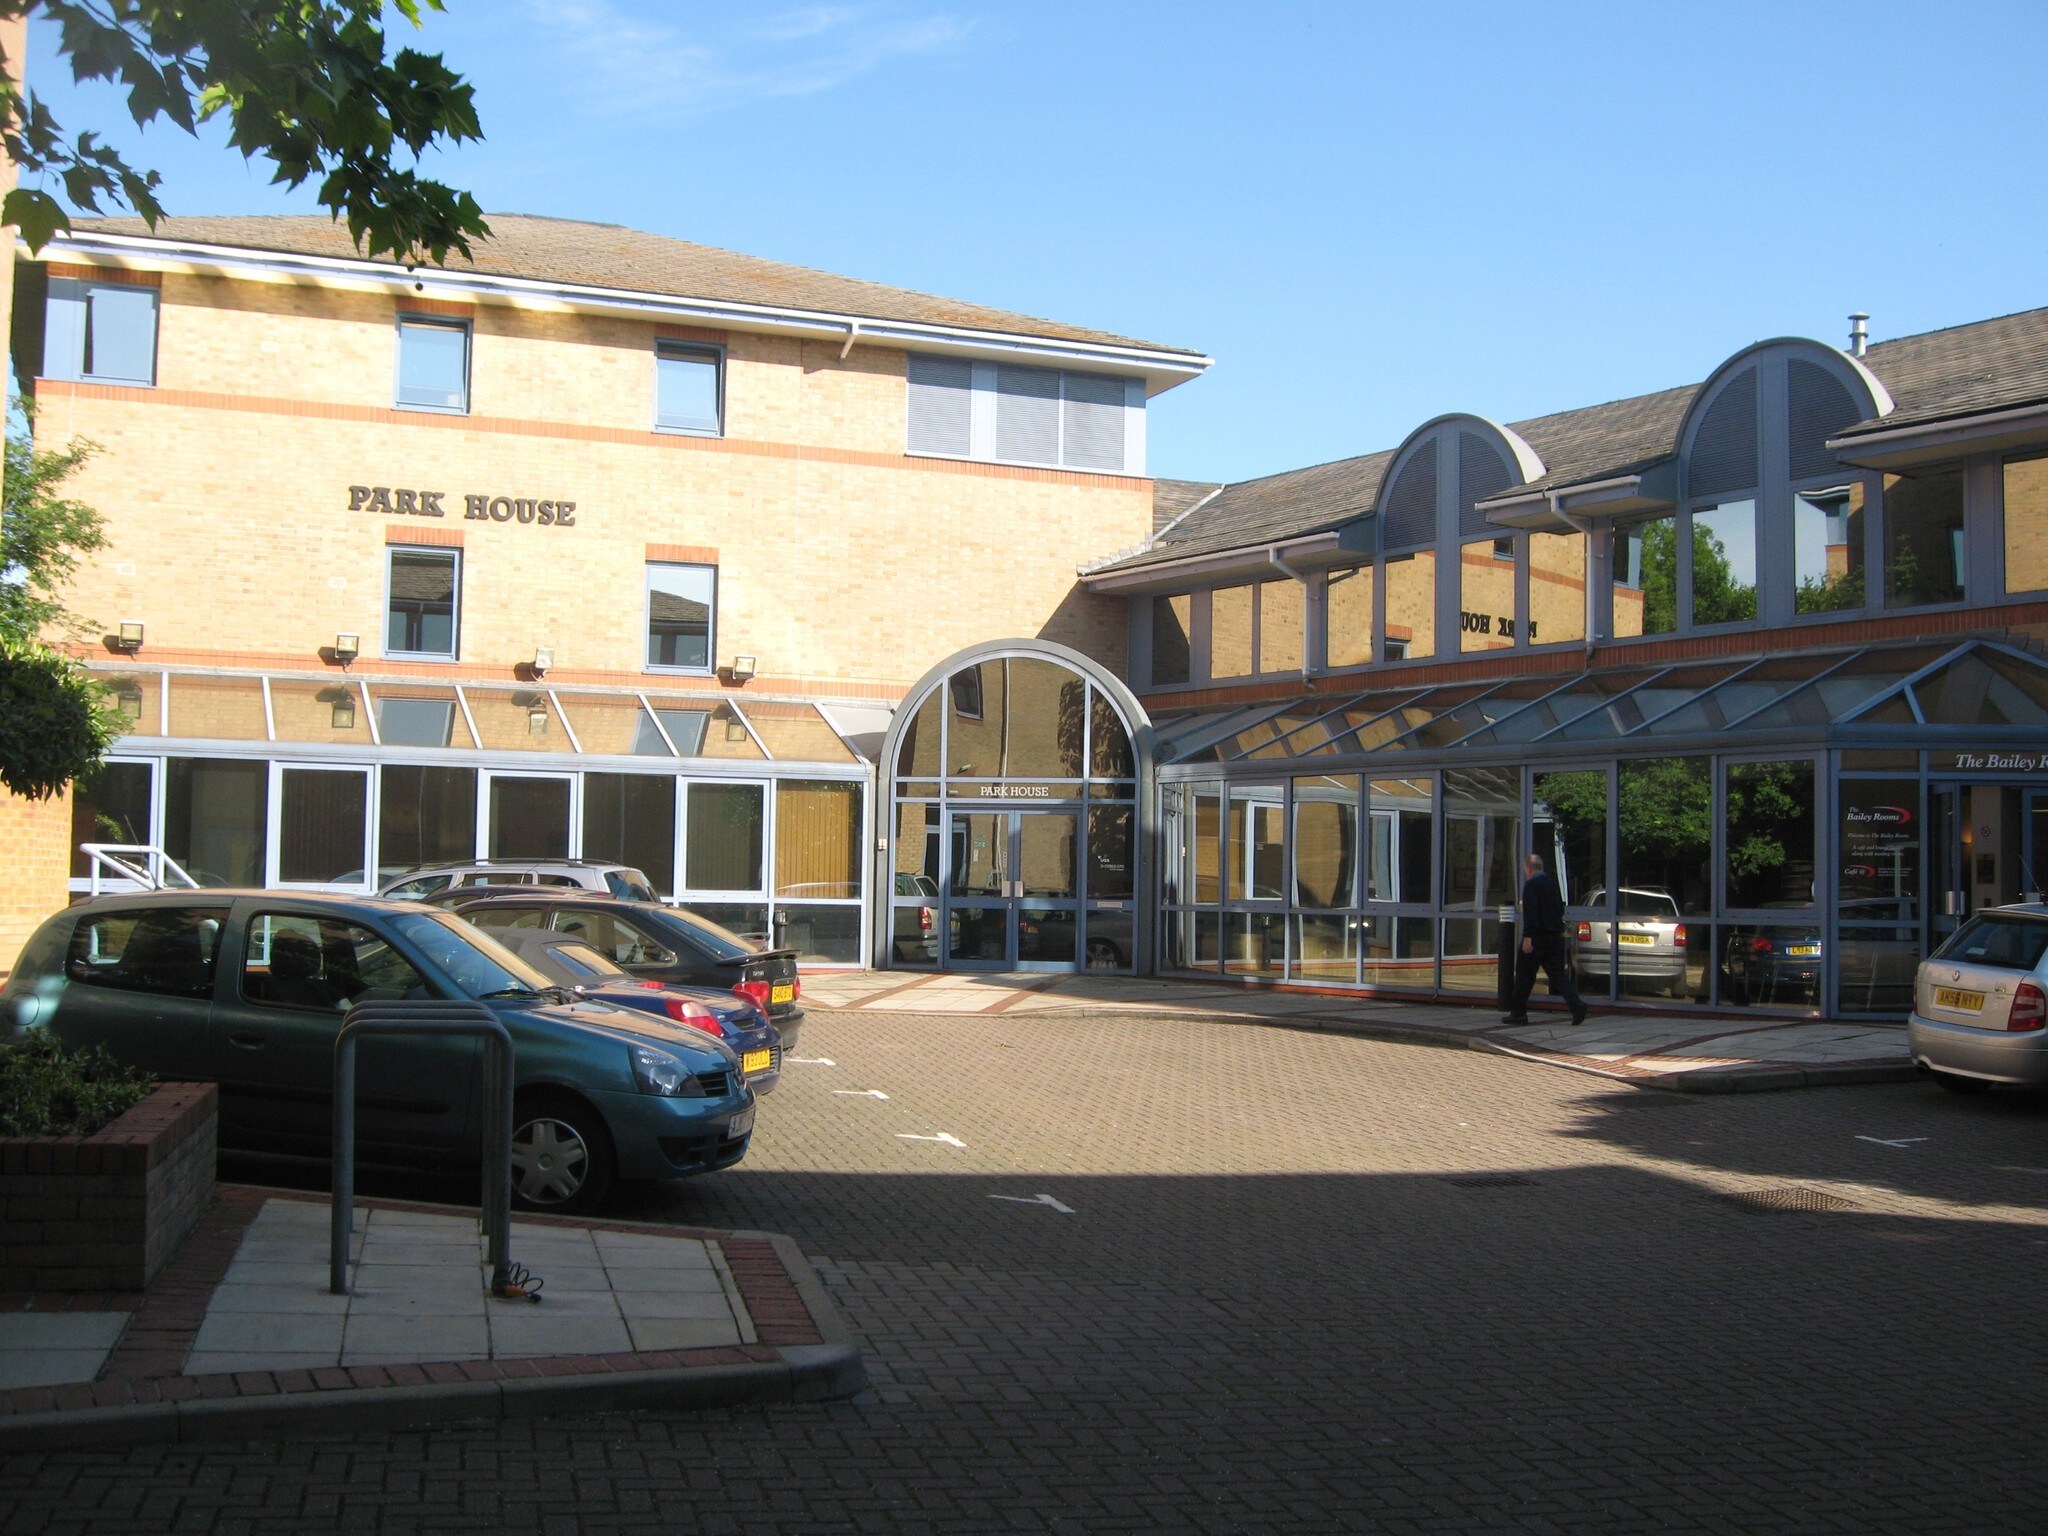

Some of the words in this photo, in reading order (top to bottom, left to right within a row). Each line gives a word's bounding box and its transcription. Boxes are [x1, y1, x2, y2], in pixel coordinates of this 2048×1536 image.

[348, 485, 445, 517] PARK
[464, 494, 576, 526] HOUSE
[1956, 754, 1983, 768] The
[1986, 754, 2036, 771] Bailey
[980, 786, 1008, 797] PARK
[1010, 786, 1049, 797] HOUSE
[1847, 813, 1872, 822] Bailey
[1873, 813, 1900, 821] Rooms
